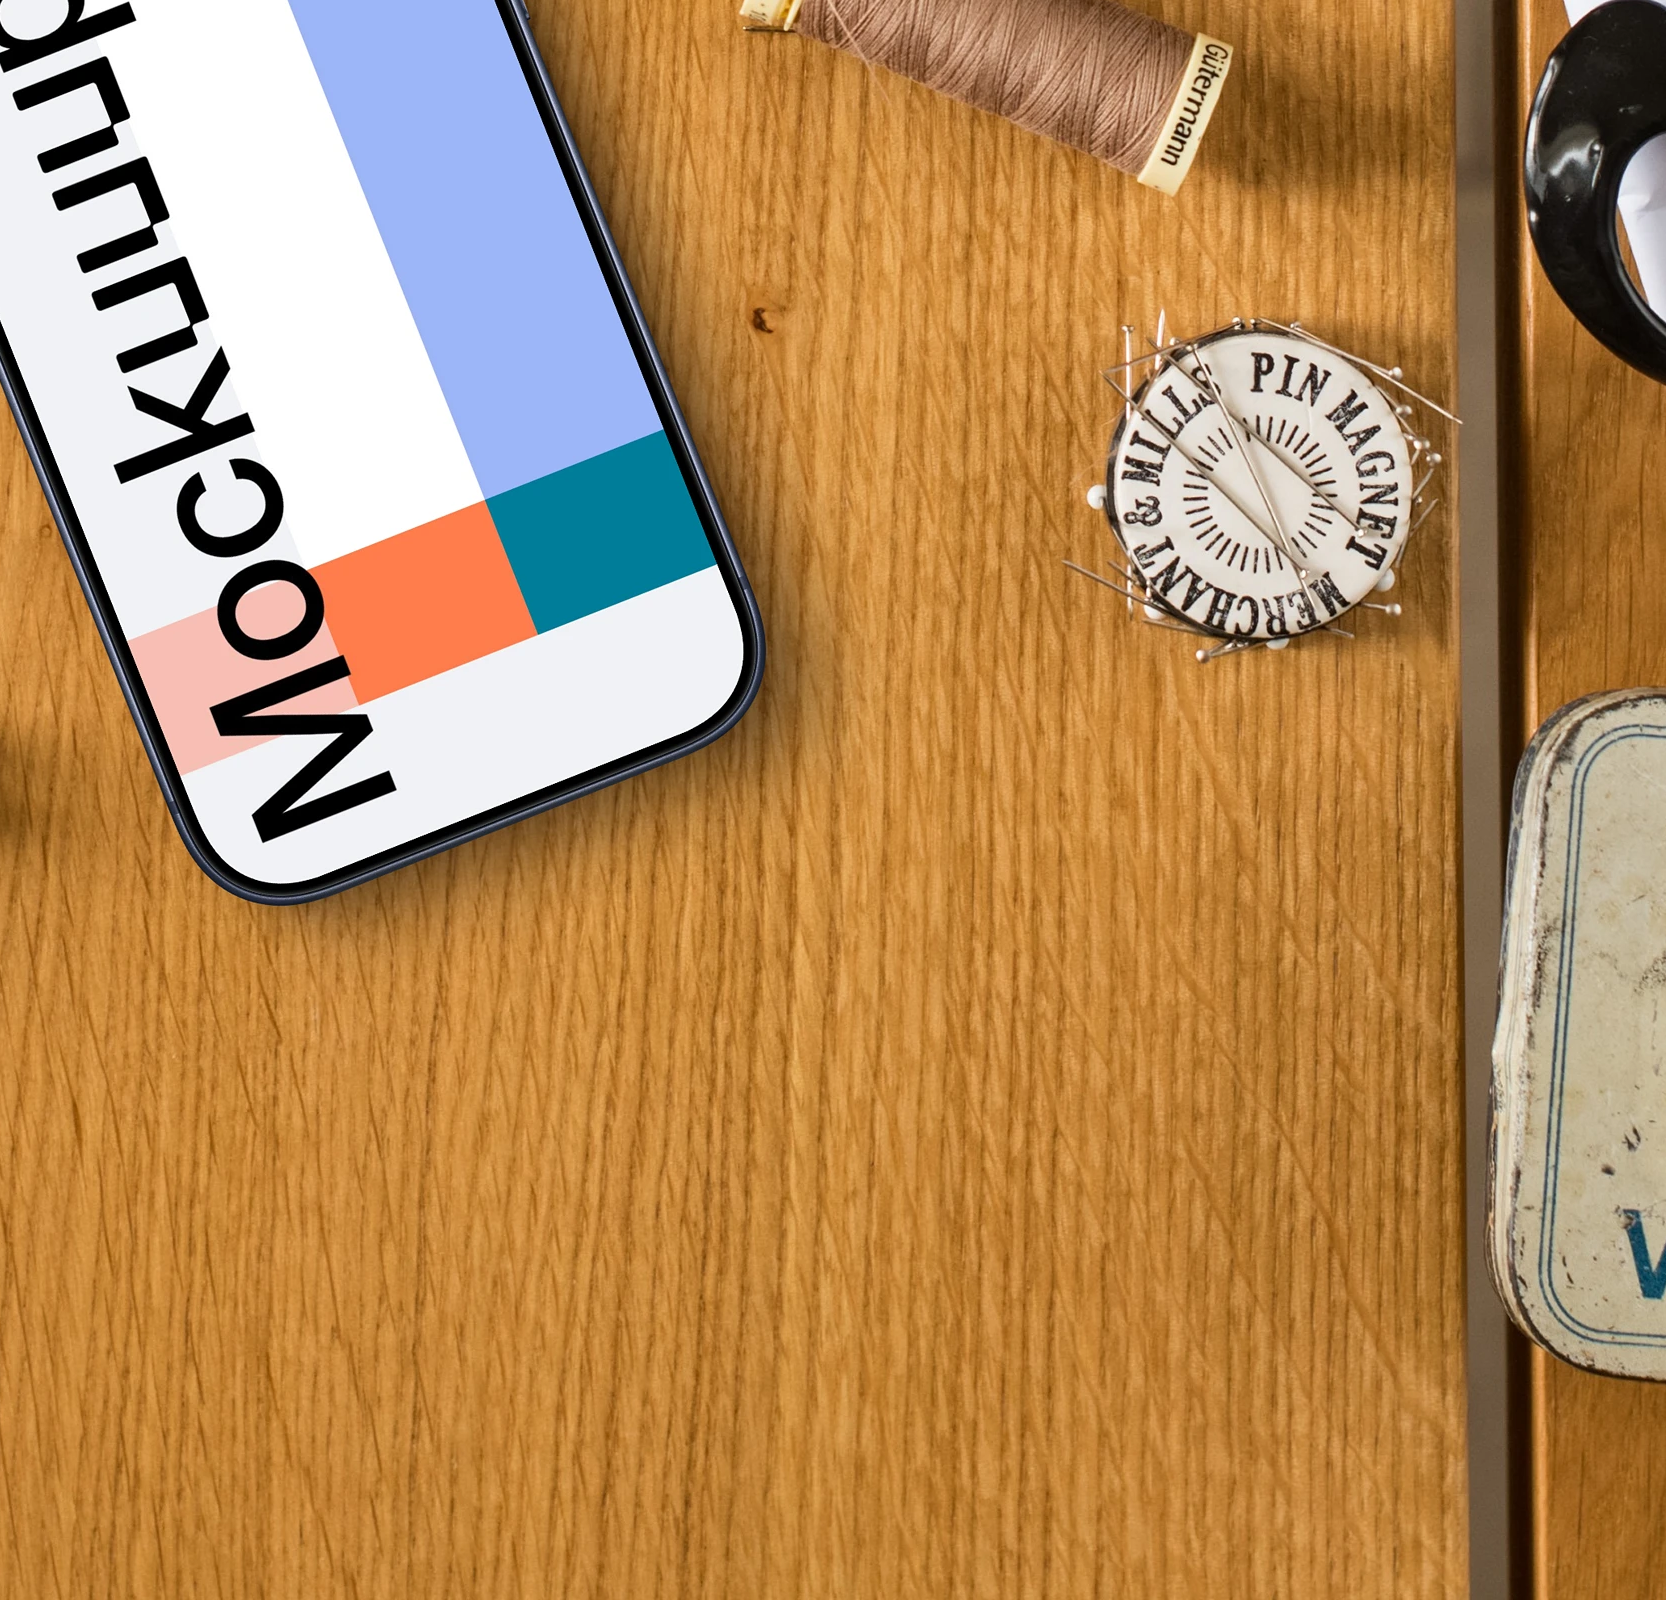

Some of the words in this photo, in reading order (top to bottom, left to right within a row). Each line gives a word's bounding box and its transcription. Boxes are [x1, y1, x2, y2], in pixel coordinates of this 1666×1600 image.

[1161, 44, 1228, 166] Gütermann
[1121, 363, 1221, 487] MILLS
[1250, 351, 1331, 407] PIN
[1325, 389, 1398, 570] MAGNET
[1123, 496, 1163, 527] &
[1133, 536, 1350, 636] MERCHANT
